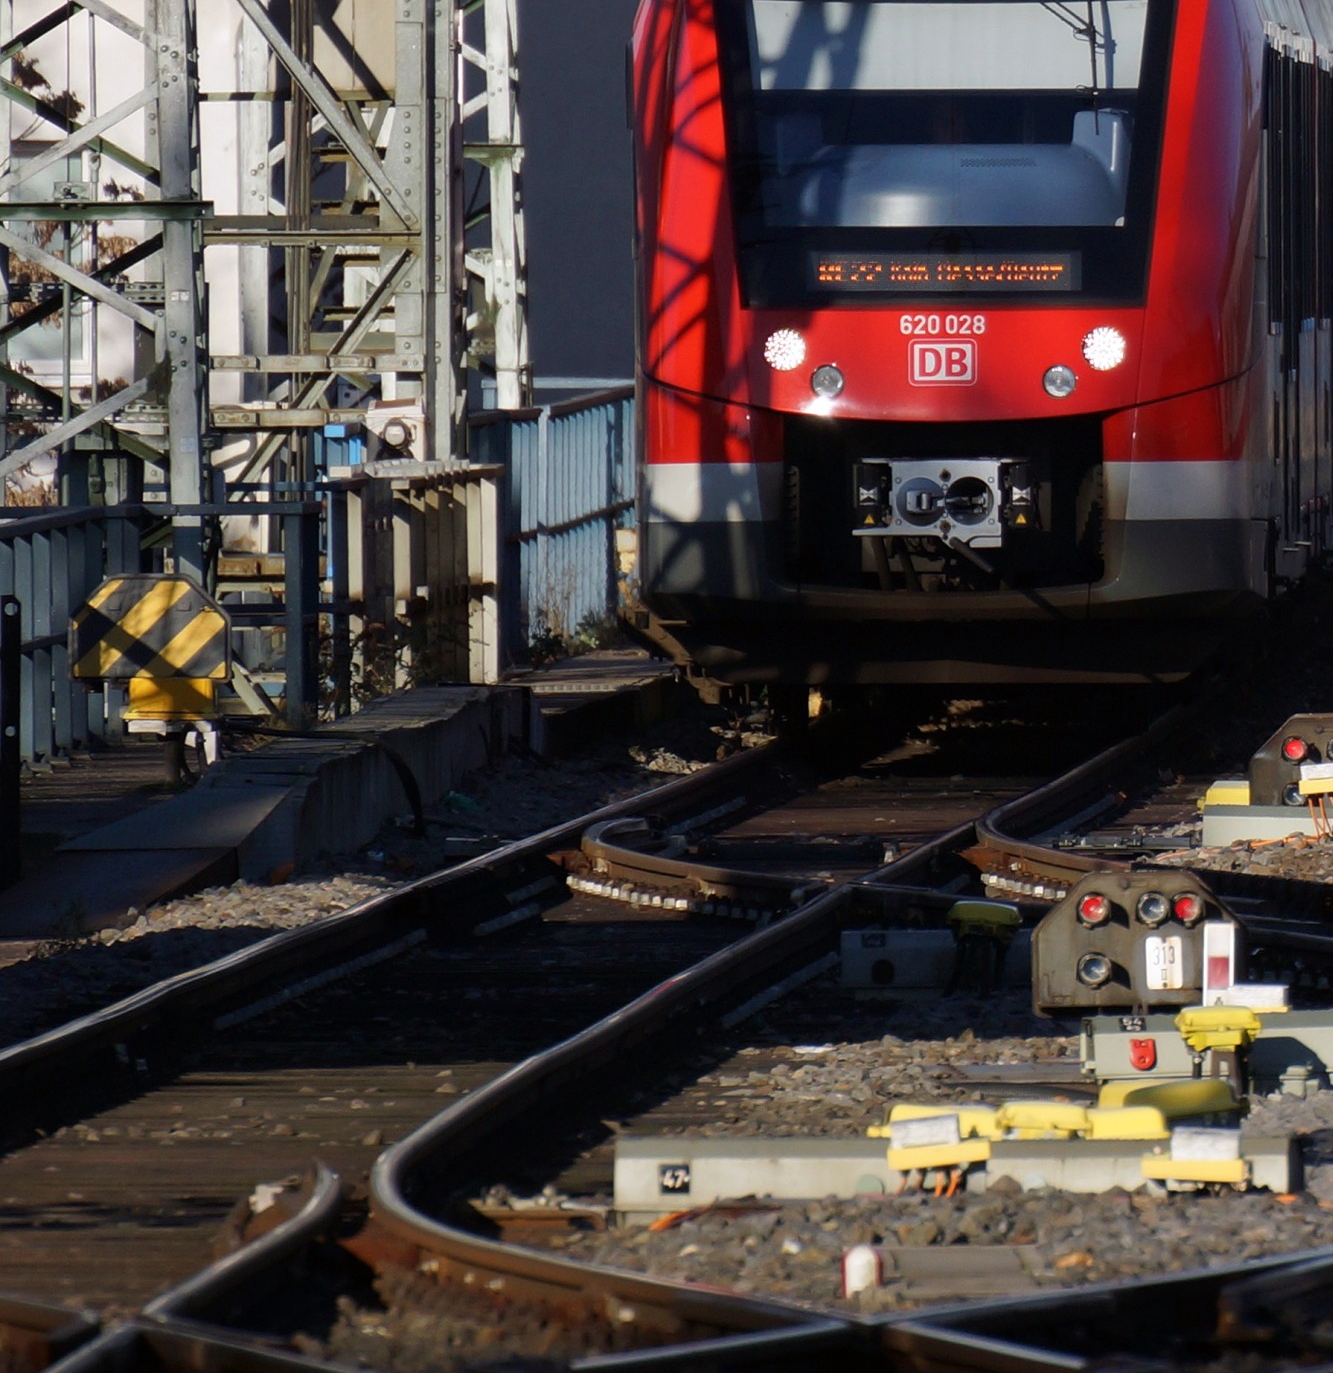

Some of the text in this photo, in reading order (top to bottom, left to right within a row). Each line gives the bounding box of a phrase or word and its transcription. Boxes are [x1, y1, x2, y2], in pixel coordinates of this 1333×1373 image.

[899, 314, 985, 335] 620 028
[918, 347, 968, 378] DB
[1152, 946, 1176, 966] 313
[663, 1169, 687, 1189] 47
